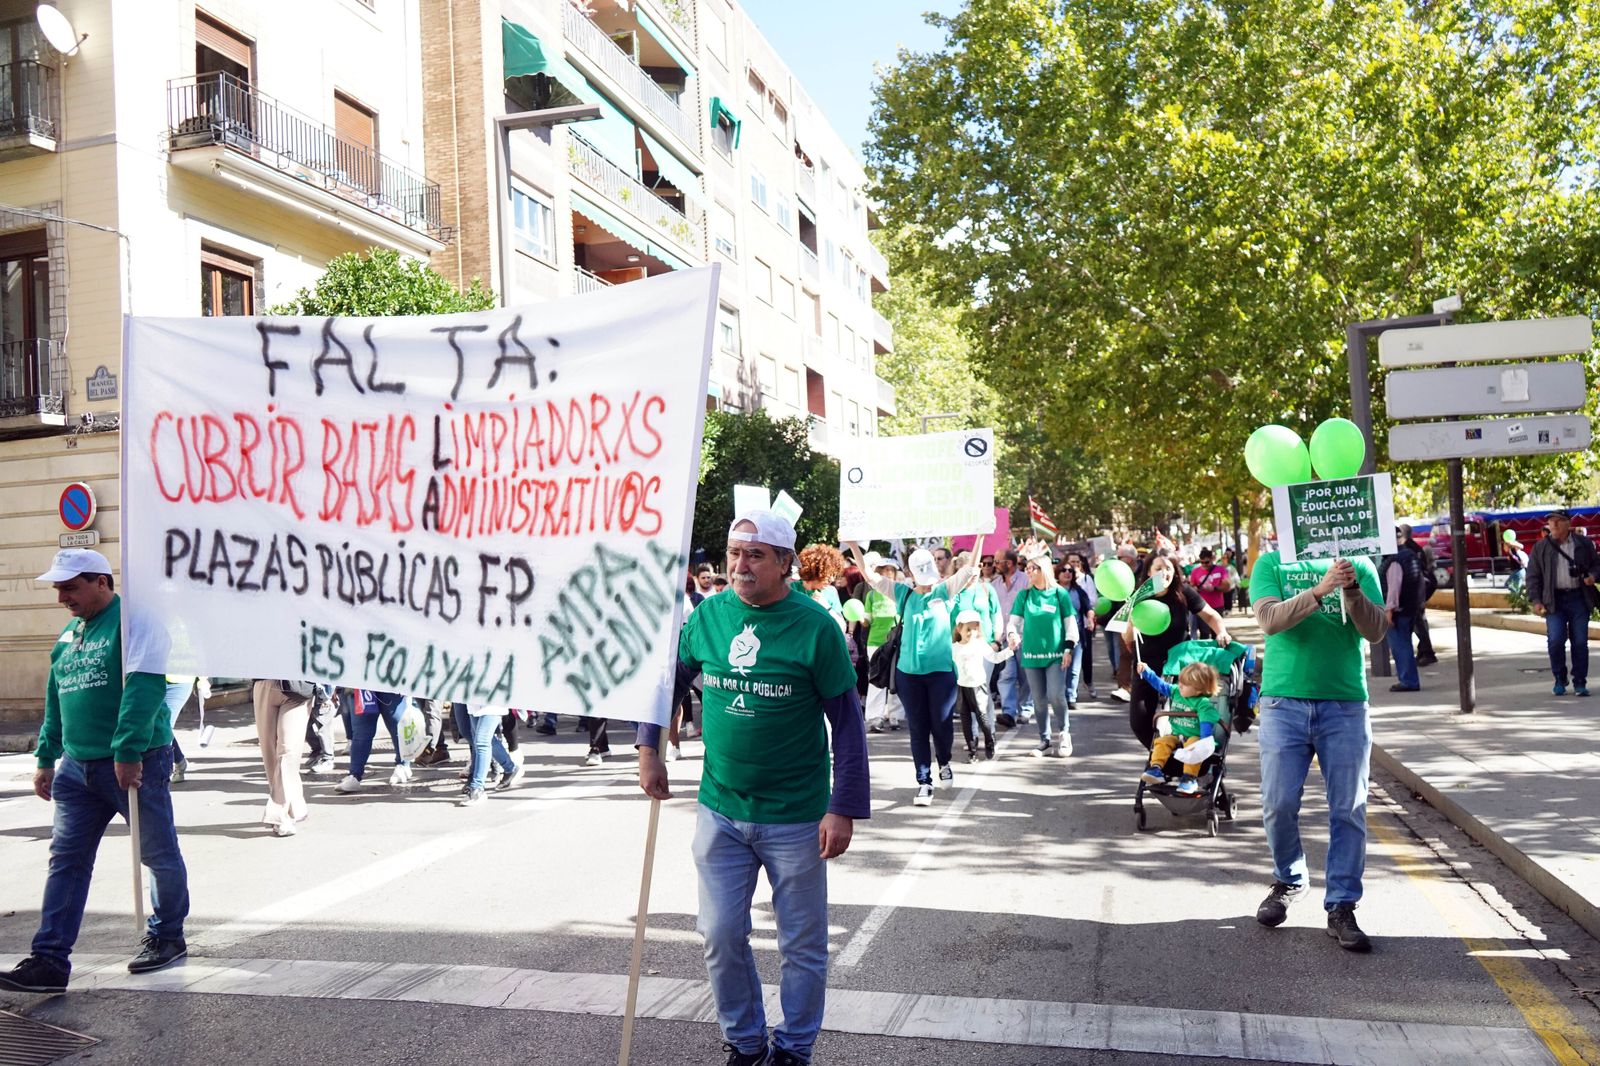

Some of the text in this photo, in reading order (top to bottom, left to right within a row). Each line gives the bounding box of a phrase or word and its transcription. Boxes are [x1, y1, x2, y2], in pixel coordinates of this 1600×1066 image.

[256, 314, 560, 401] FALTA:
[1305, 485, 1358, 501] ¡POR UNA
[1301, 496, 1364, 512] EDUCACIÓN
[1296, 510, 1373, 526] PÚBLICA Y DE
[165, 528, 536, 627] PLAZAS PÚBLICAS F.P.
[538, 542, 639, 687] AMPA
[411, 644, 514, 702] AYALA
[80, 680, 108, 689] Verde
[723, 678, 738, 691] POR
[740, 681, 750, 692] LA
[753, 680, 792, 697] PÚBLICA!
